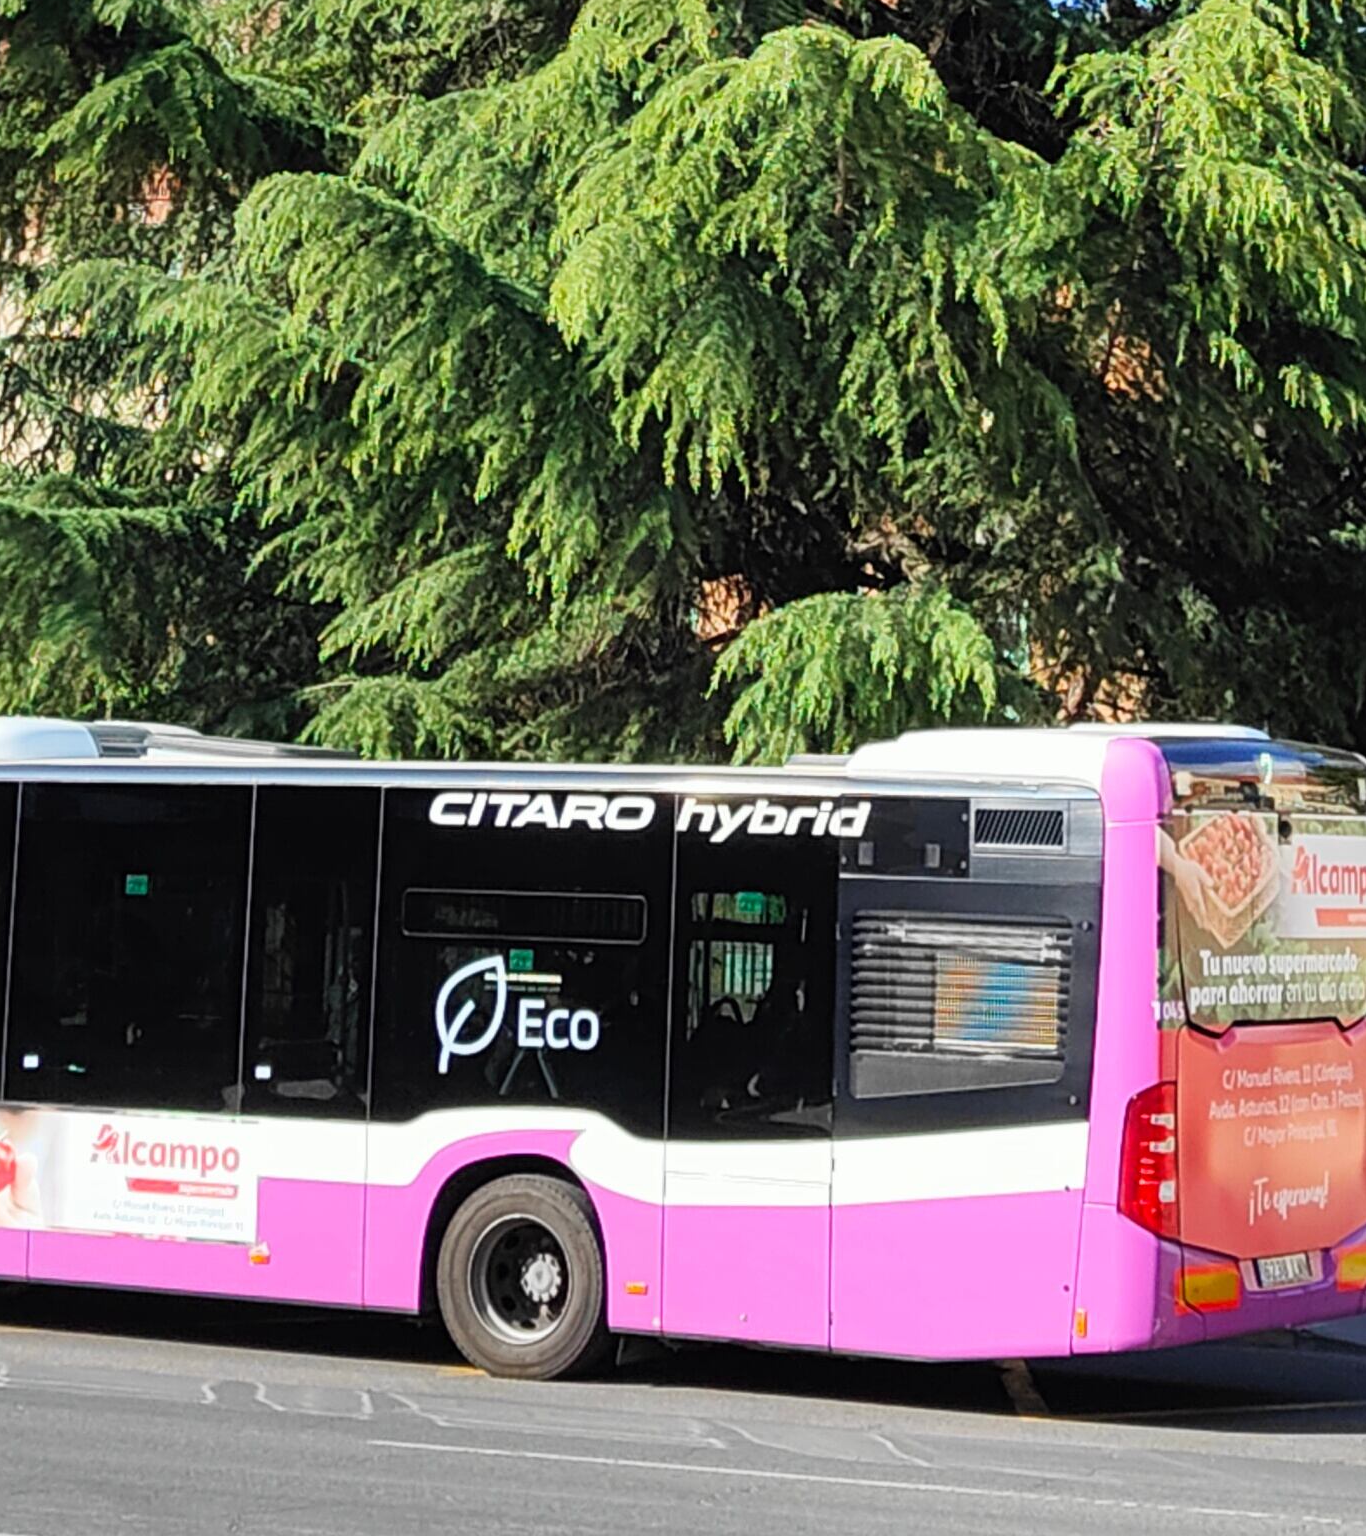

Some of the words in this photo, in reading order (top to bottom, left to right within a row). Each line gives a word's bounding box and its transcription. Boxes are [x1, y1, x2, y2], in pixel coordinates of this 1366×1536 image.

[429, 792, 656, 831] CITARO
[676, 798, 872, 843] hybrid
[1199, 949, 1220, 976] Tu
[1222, 953, 1267, 976] nuevo
[1269, 946, 1358, 981] supermercado
[1190, 985, 1226, 1015] para
[1229, 977, 1284, 1006] ahorrar
[90, 1124, 241, 1178] Alcampo
